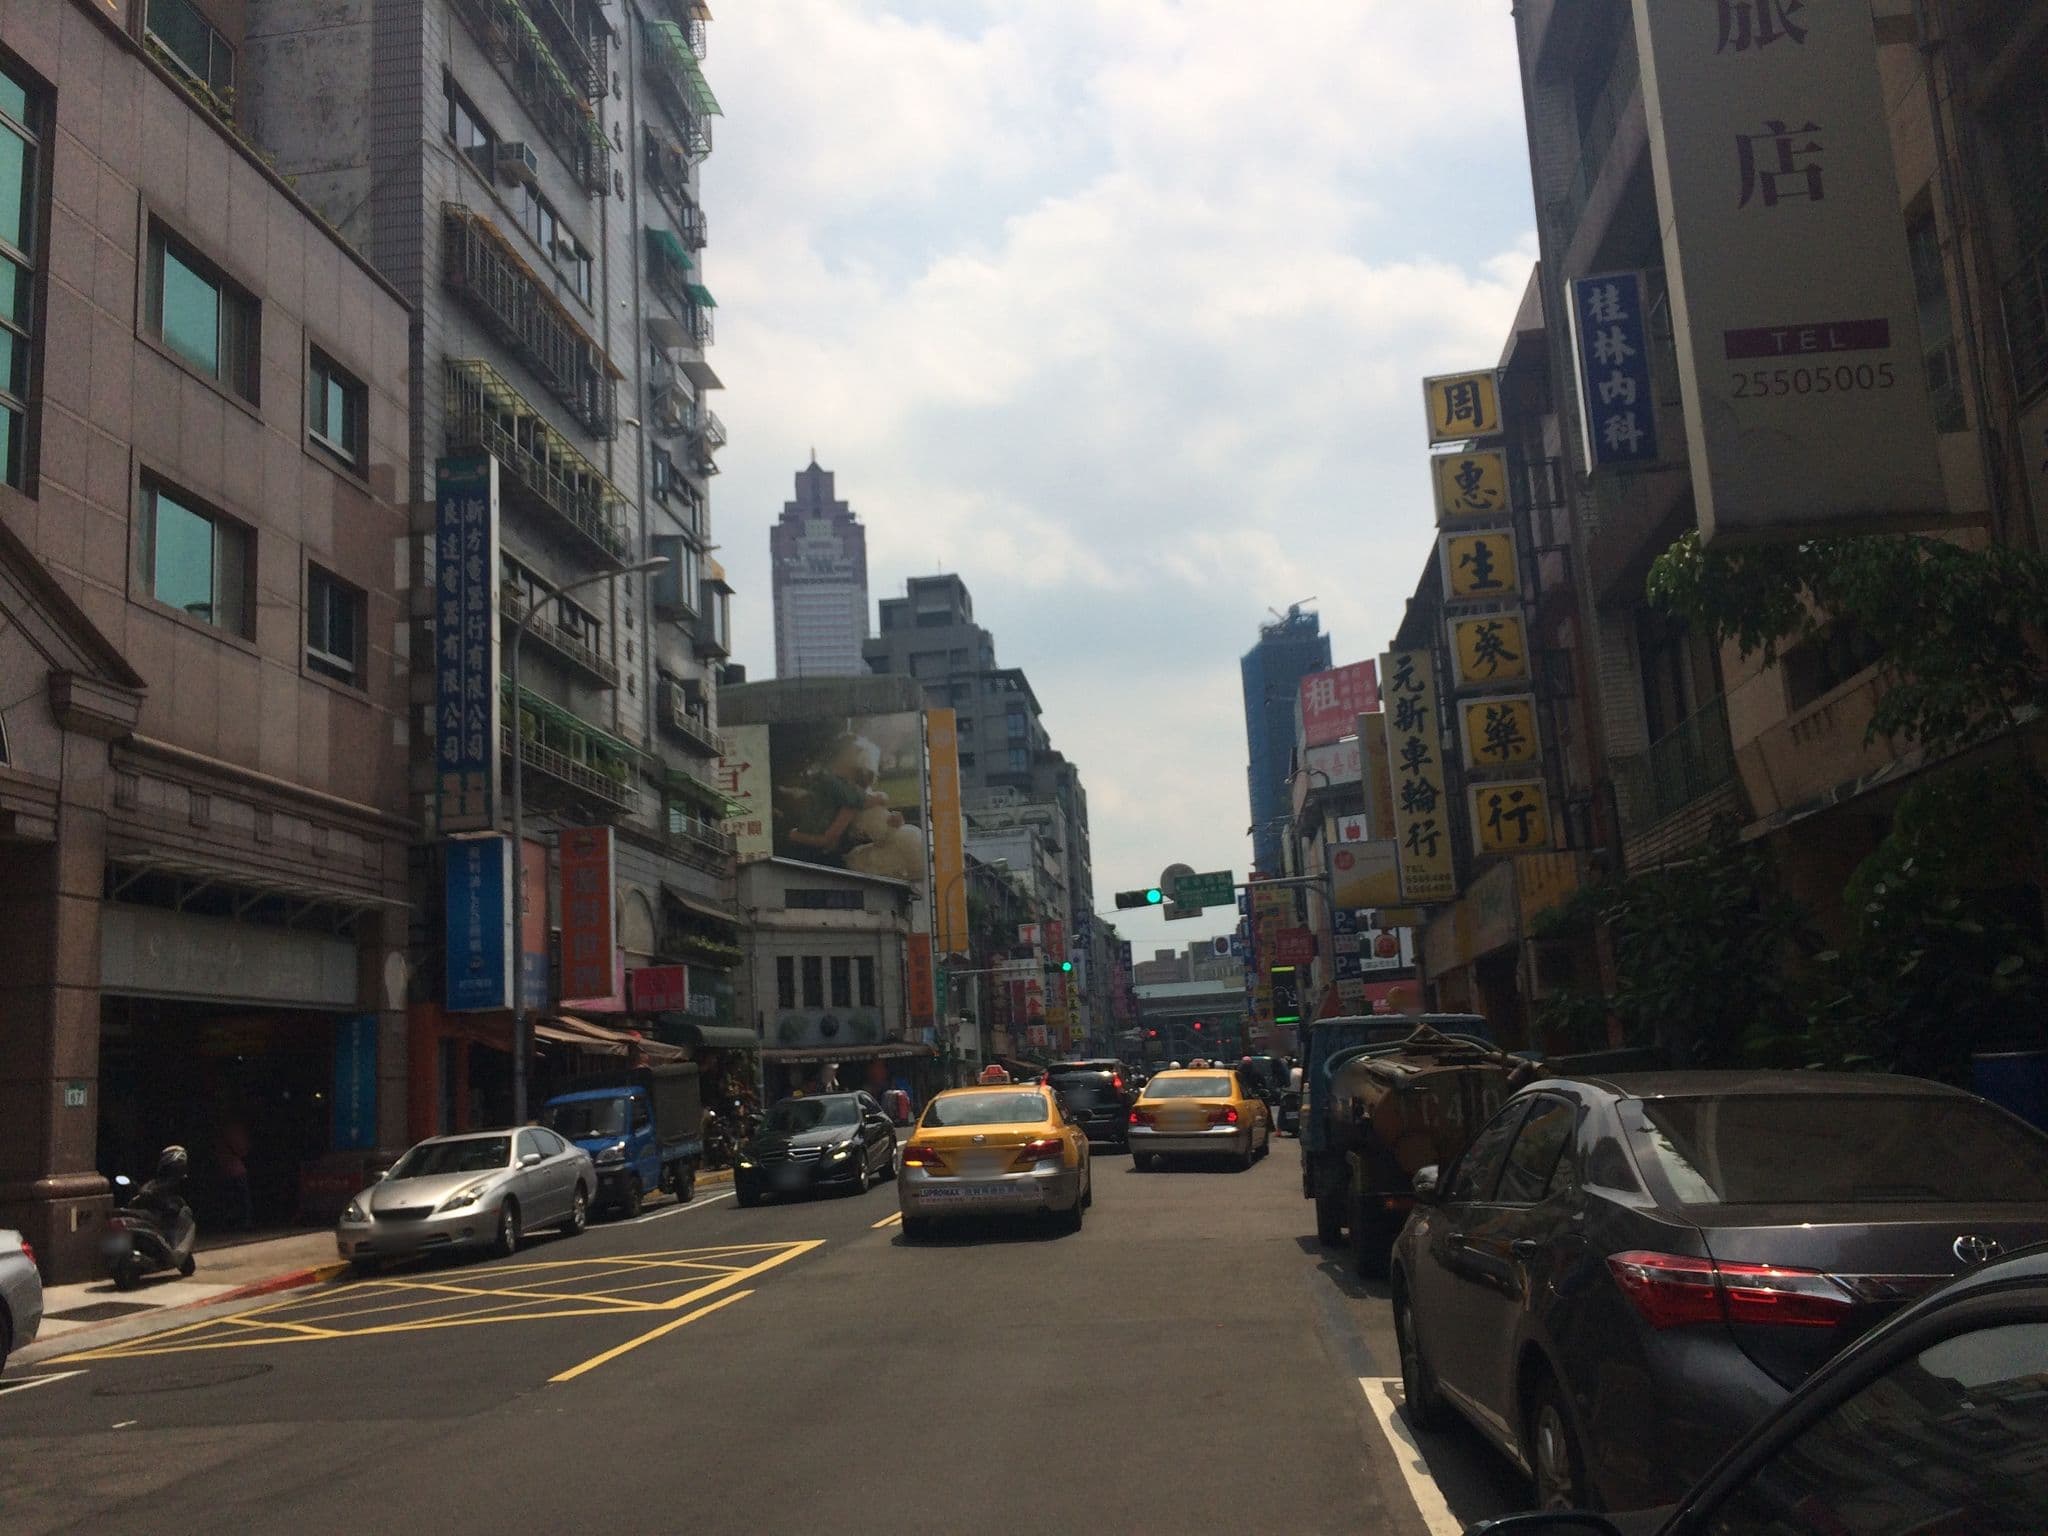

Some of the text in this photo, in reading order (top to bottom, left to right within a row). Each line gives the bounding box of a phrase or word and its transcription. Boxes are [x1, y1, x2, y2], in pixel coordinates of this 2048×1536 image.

[1771, 328, 1846, 352] TEL
[1588, 284, 1645, 453] 桂林內科
[1732, 361, 1896, 398] 25505005
[1303, 678, 1341, 718] 租
[1391, 654, 1441, 858] 元新車輪行
